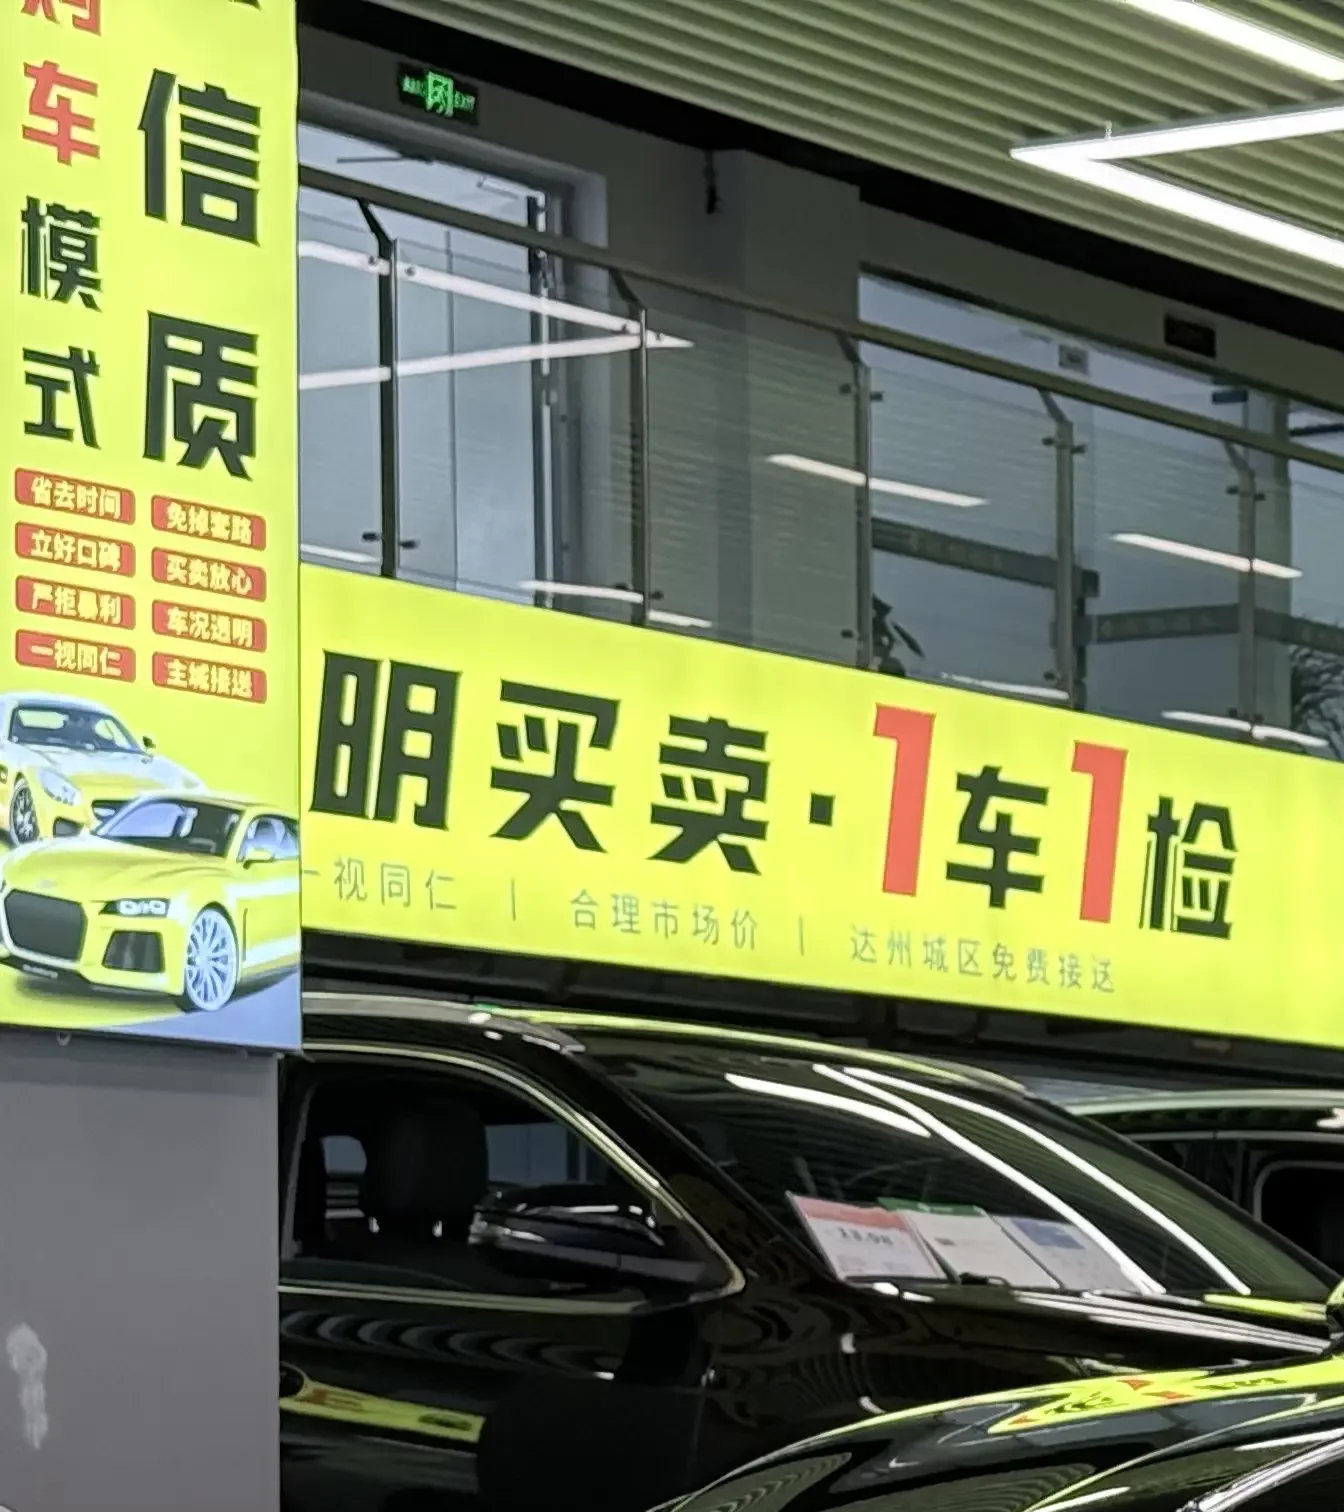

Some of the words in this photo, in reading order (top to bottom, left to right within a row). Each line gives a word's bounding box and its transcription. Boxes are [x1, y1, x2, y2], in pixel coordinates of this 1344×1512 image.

[31, 475, 121, 519] 省去时间
[167, 501, 252, 545] 免掉套路
[31, 529, 121, 571] 立好口碑
[167, 554, 252, 596] 买卖放心
[167, 606, 253, 648] 车况透明
[31, 640, 121, 676] 一视同仁
[570, 888, 758, 951] 合理市场价
[850, 924, 1115, 994] 达州城区免费接送
